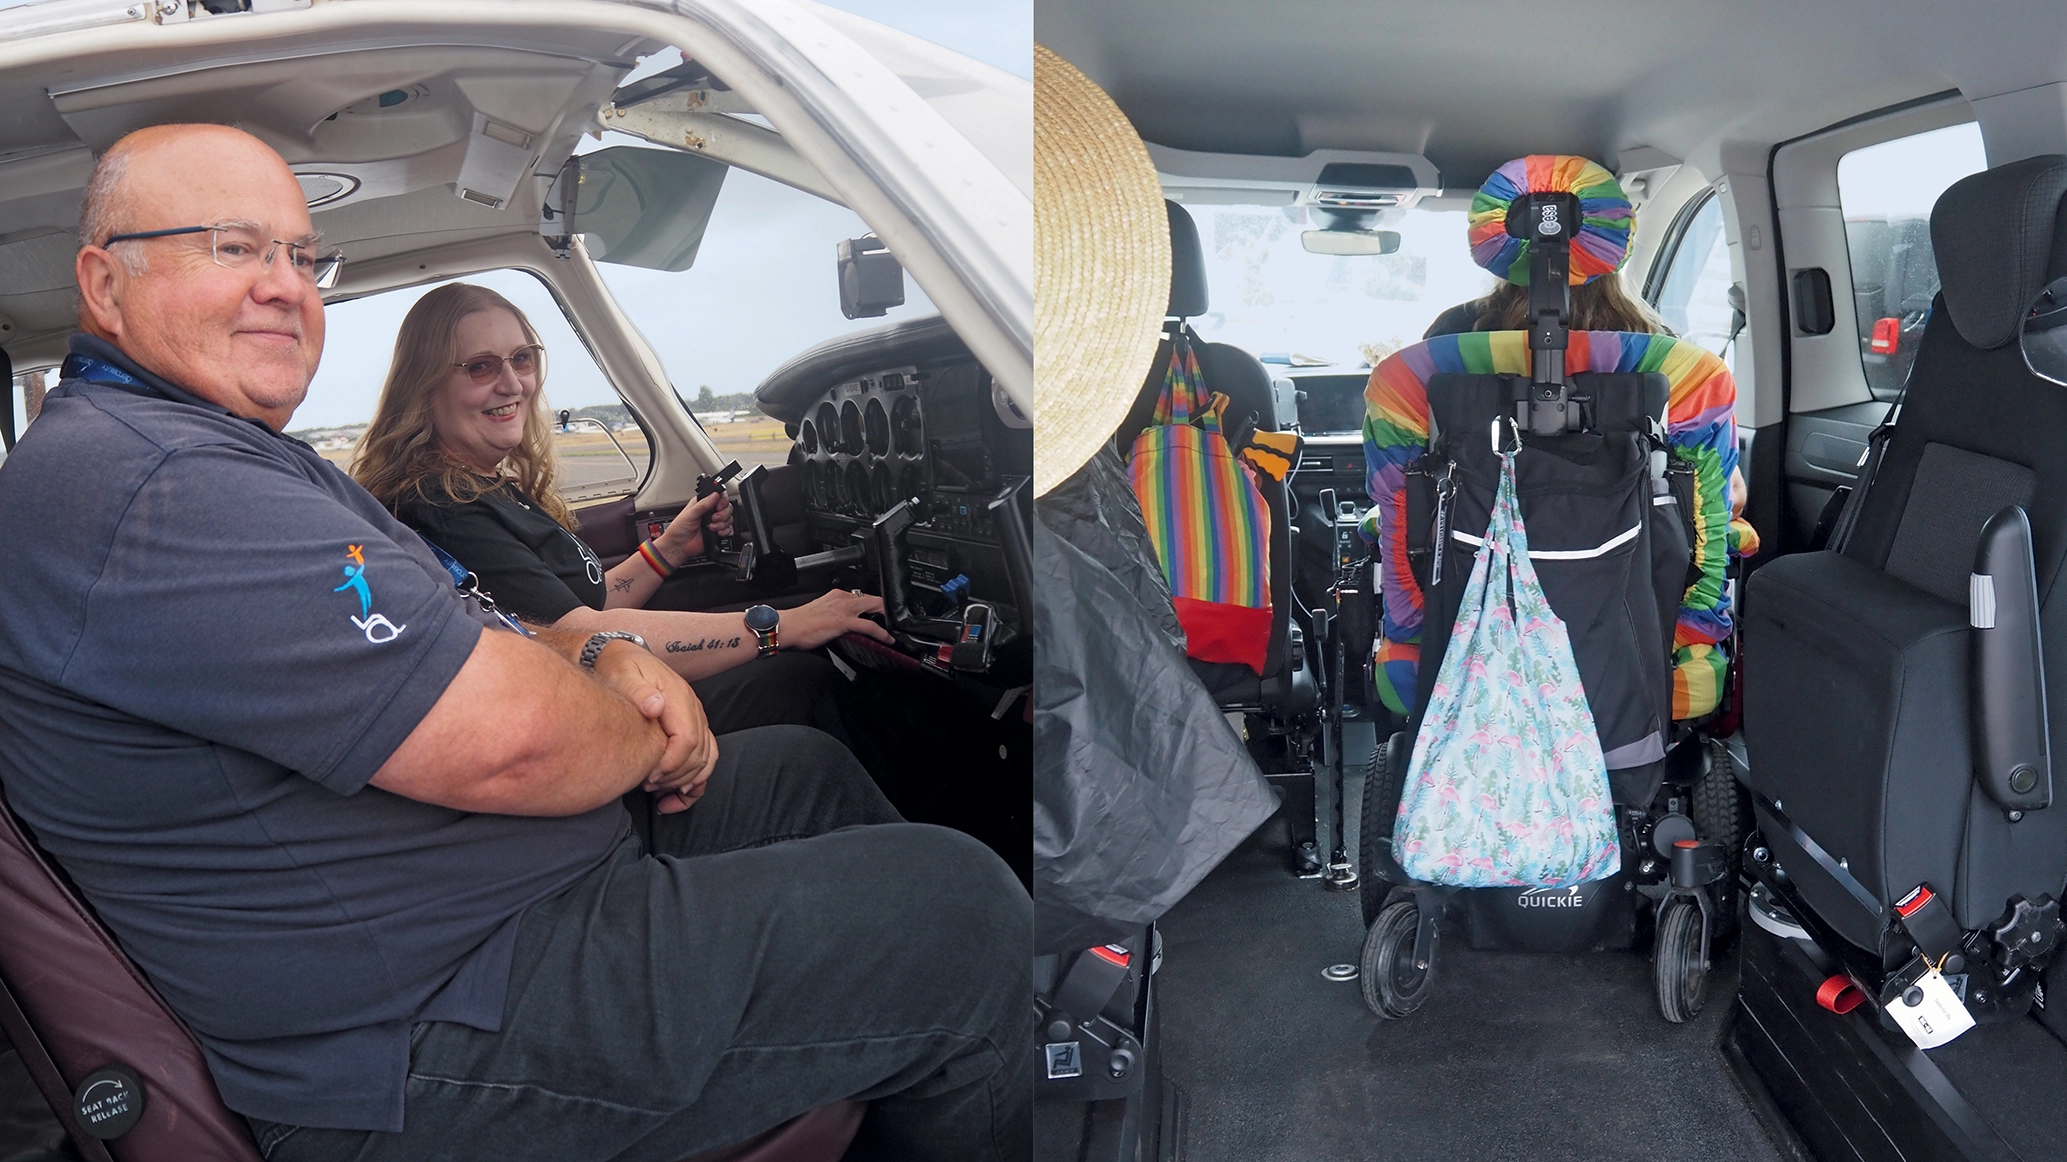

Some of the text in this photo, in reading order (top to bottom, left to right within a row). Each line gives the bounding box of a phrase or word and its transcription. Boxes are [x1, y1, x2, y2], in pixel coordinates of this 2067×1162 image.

[665, 638, 706, 654] Isaiah
[1518, 895, 1582, 908] QUICKIE
[81, 1100, 103, 1116] SEAT
